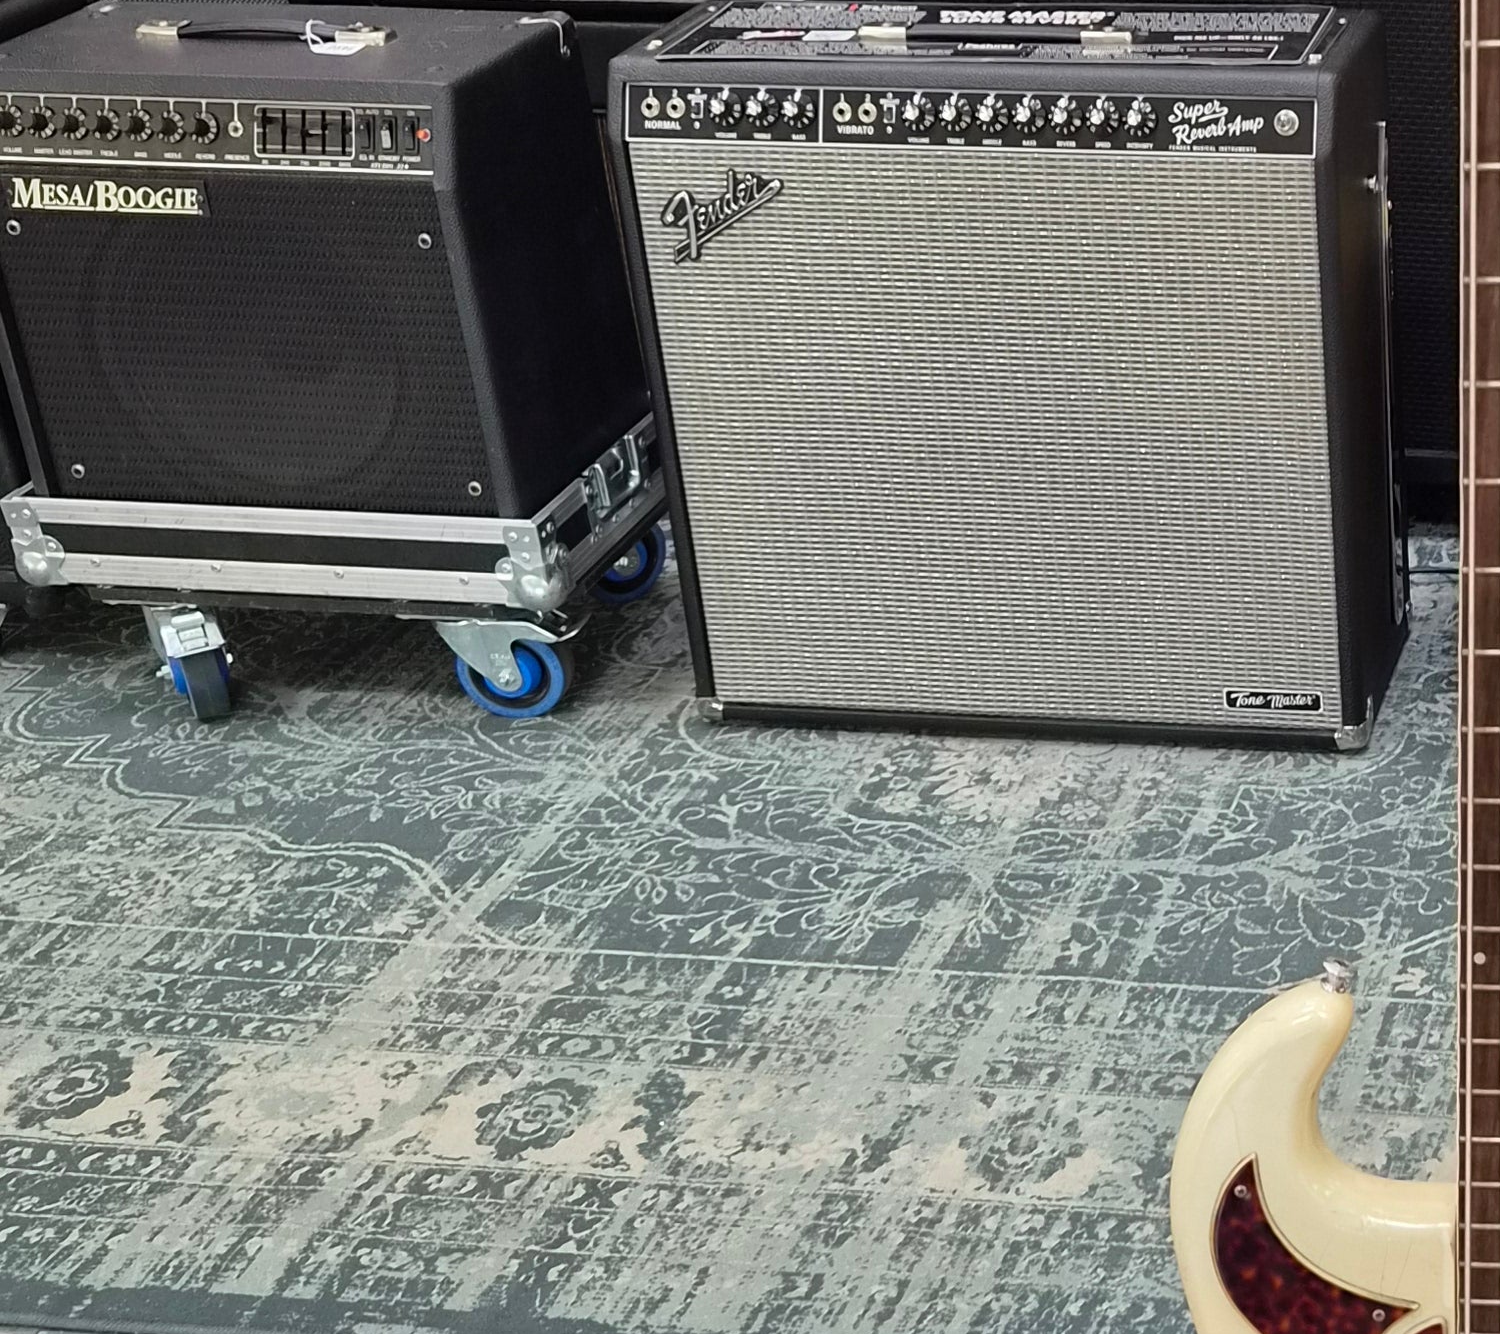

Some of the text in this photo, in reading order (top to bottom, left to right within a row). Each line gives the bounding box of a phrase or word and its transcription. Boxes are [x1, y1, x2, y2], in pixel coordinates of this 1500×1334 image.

[1168, 99, 1229, 124] Super
[644, 120, 682, 130] NORMAL
[836, 125, 875, 136] VIBRATO
[12, 178, 199, 212] MESA/BOOGIE
[662, 168, 783, 264] Fender
[1230, 692, 1313, 709] Tone Master
